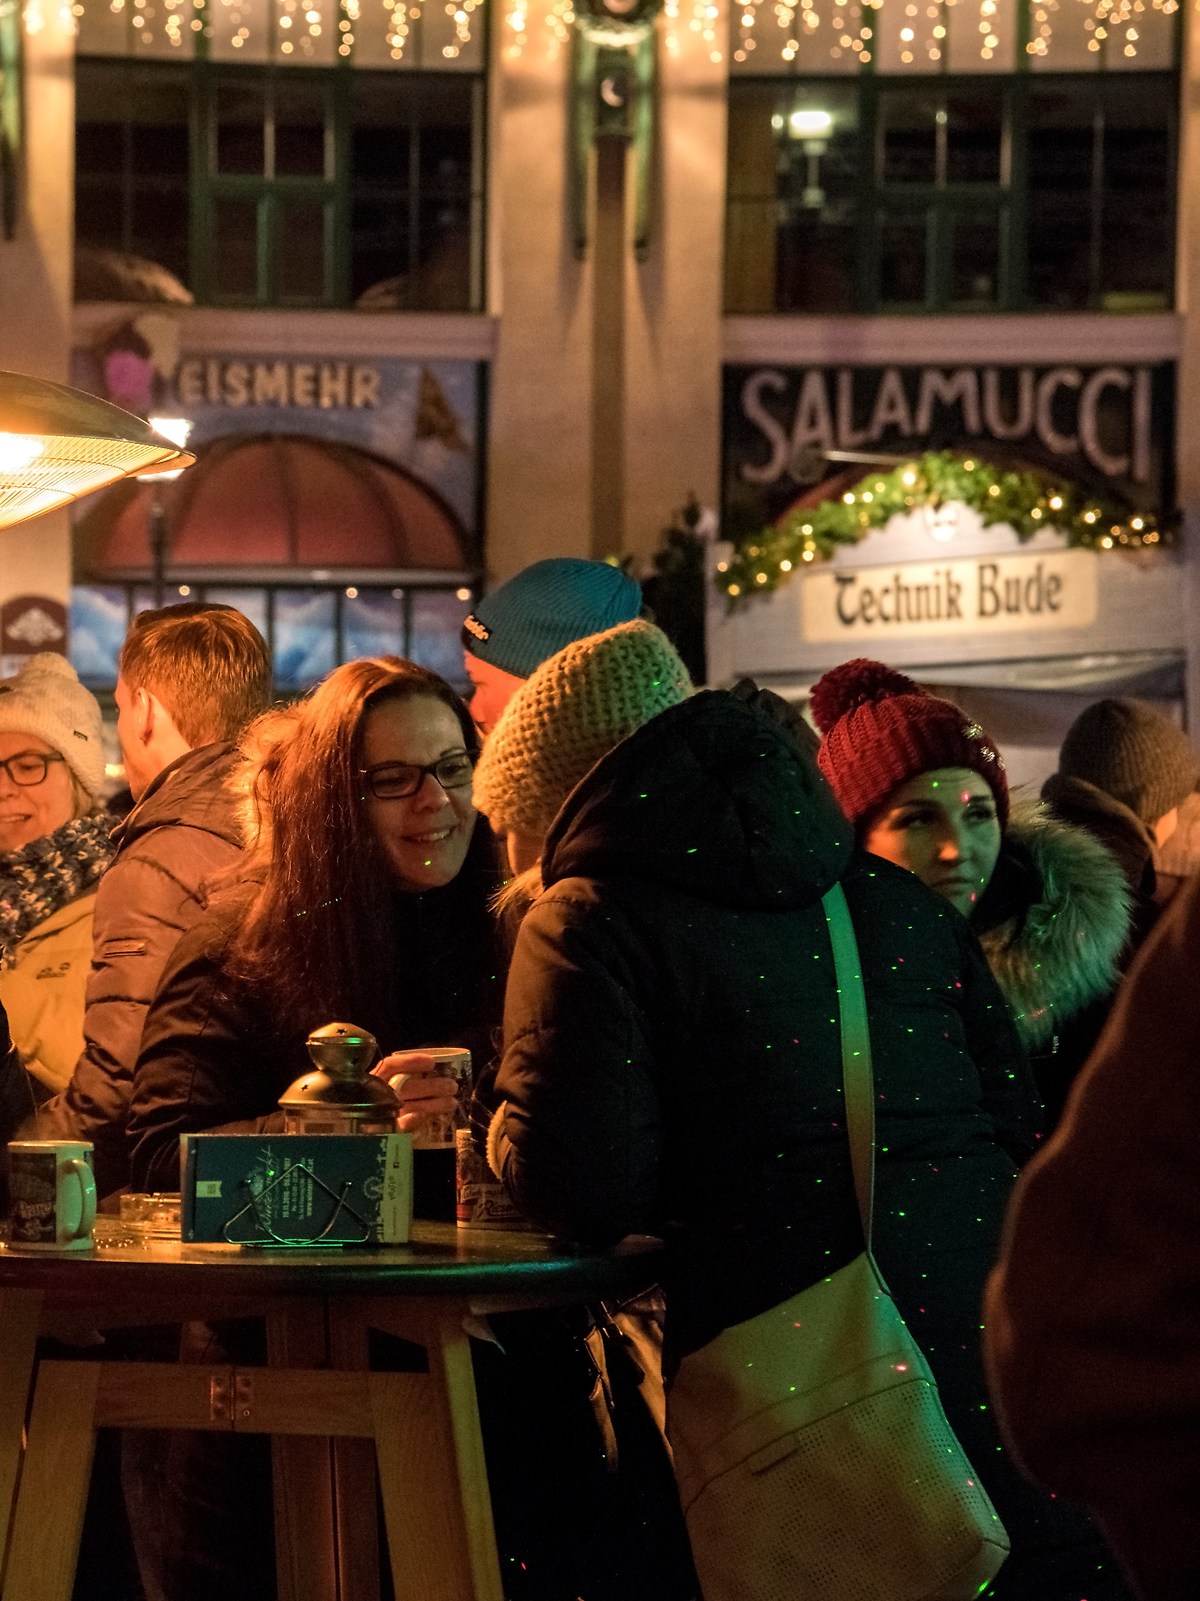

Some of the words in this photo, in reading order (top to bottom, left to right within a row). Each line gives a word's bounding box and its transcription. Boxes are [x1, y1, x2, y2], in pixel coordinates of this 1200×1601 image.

[178, 359, 382, 409] EISMEHR
[740, 367, 1153, 485] SALAMUCCI
[833, 568, 963, 626] Technik
[977, 561, 1063, 617] Bude
